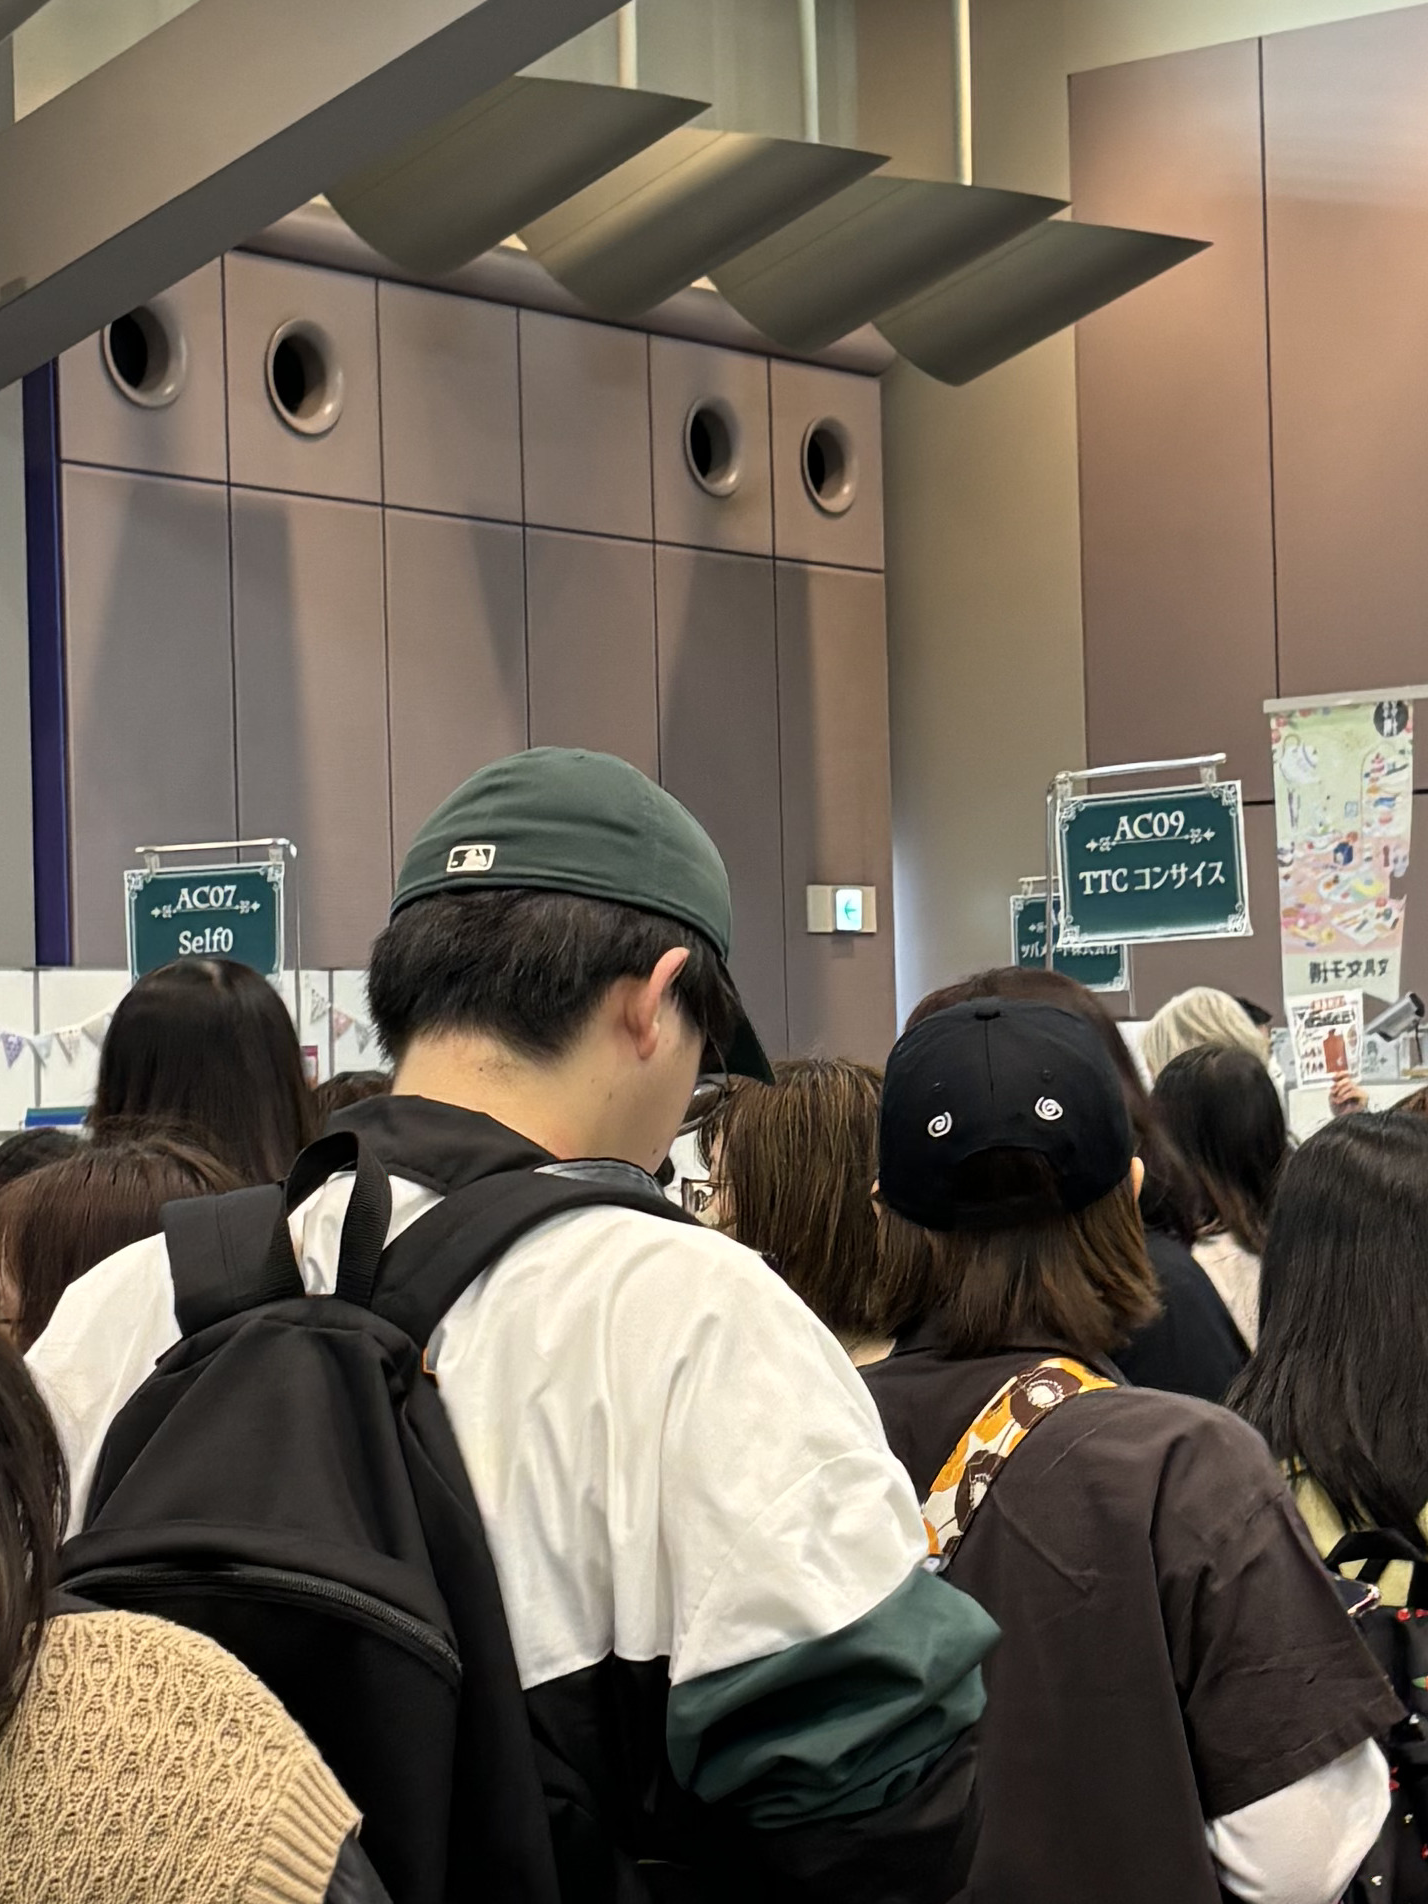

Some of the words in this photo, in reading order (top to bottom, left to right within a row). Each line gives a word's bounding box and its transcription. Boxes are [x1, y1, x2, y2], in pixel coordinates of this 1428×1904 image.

[1113, 810, 1186, 841] AC09
[1078, 867, 1129, 895] TTC
[1133, 861, 1226, 890] コンサイス
[175, 884, 237, 910] AC07
